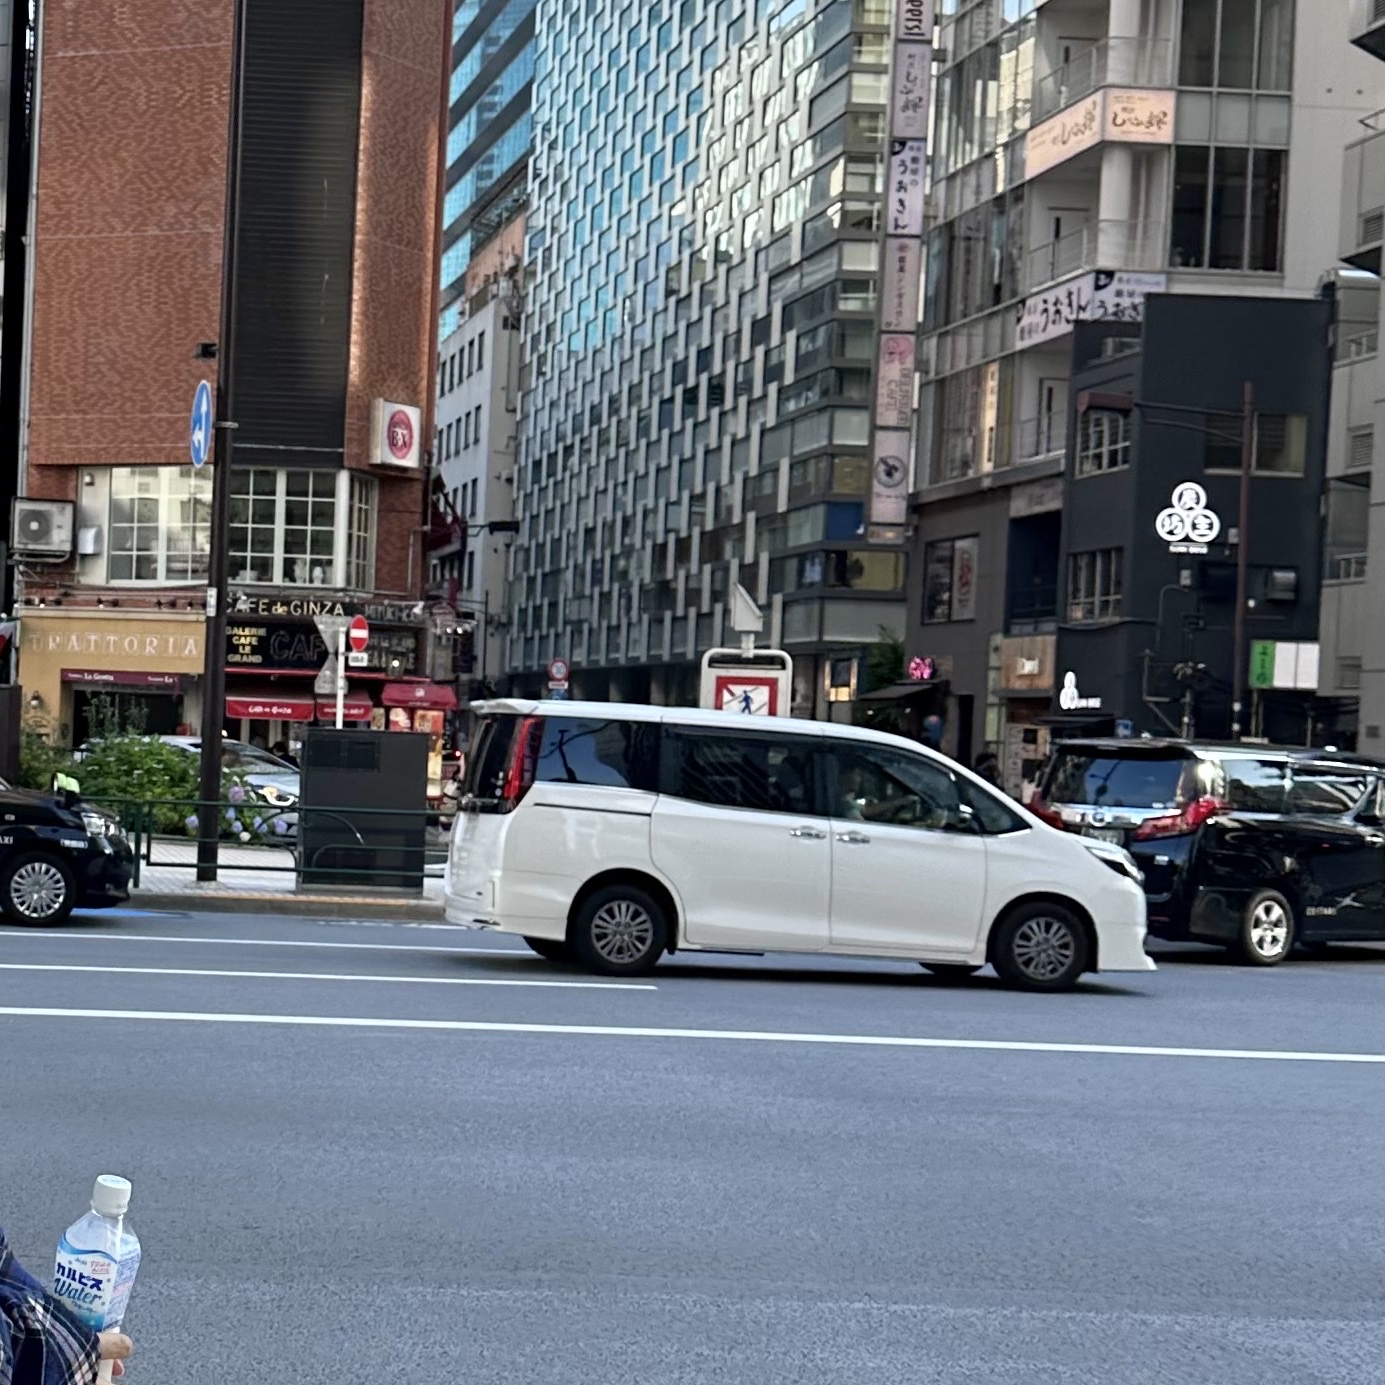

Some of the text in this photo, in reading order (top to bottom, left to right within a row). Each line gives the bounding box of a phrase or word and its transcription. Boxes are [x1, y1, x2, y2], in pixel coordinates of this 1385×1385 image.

[271, 600, 288, 615] de
[290, 600, 345, 616] GINZA
[29, 633, 199, 656] TRATTORIA
[232, 636, 259, 646] CAFE
[54, 1278, 103, 1304] Water
